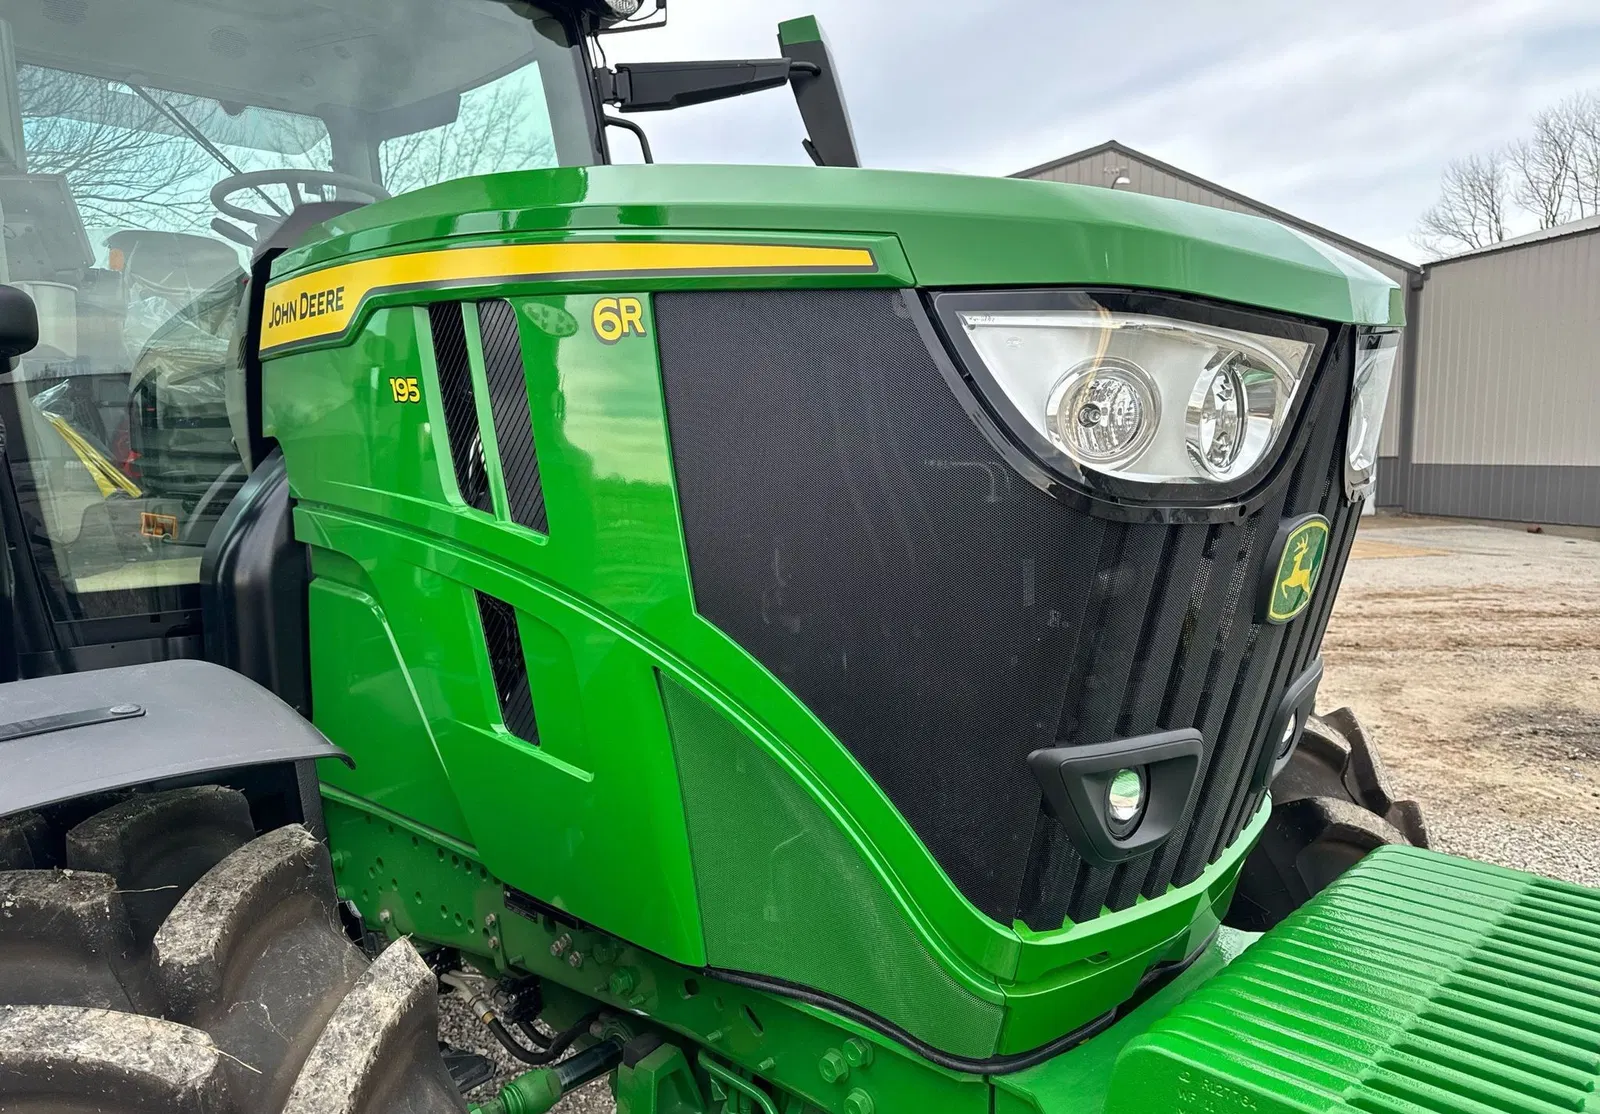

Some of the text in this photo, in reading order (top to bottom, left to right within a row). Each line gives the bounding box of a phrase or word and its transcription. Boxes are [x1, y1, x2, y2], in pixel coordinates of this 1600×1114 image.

[268, 286, 345, 328] JOHN DEERE
[591, 296, 647, 345] 6R
[389, 377, 421, 403] 195
